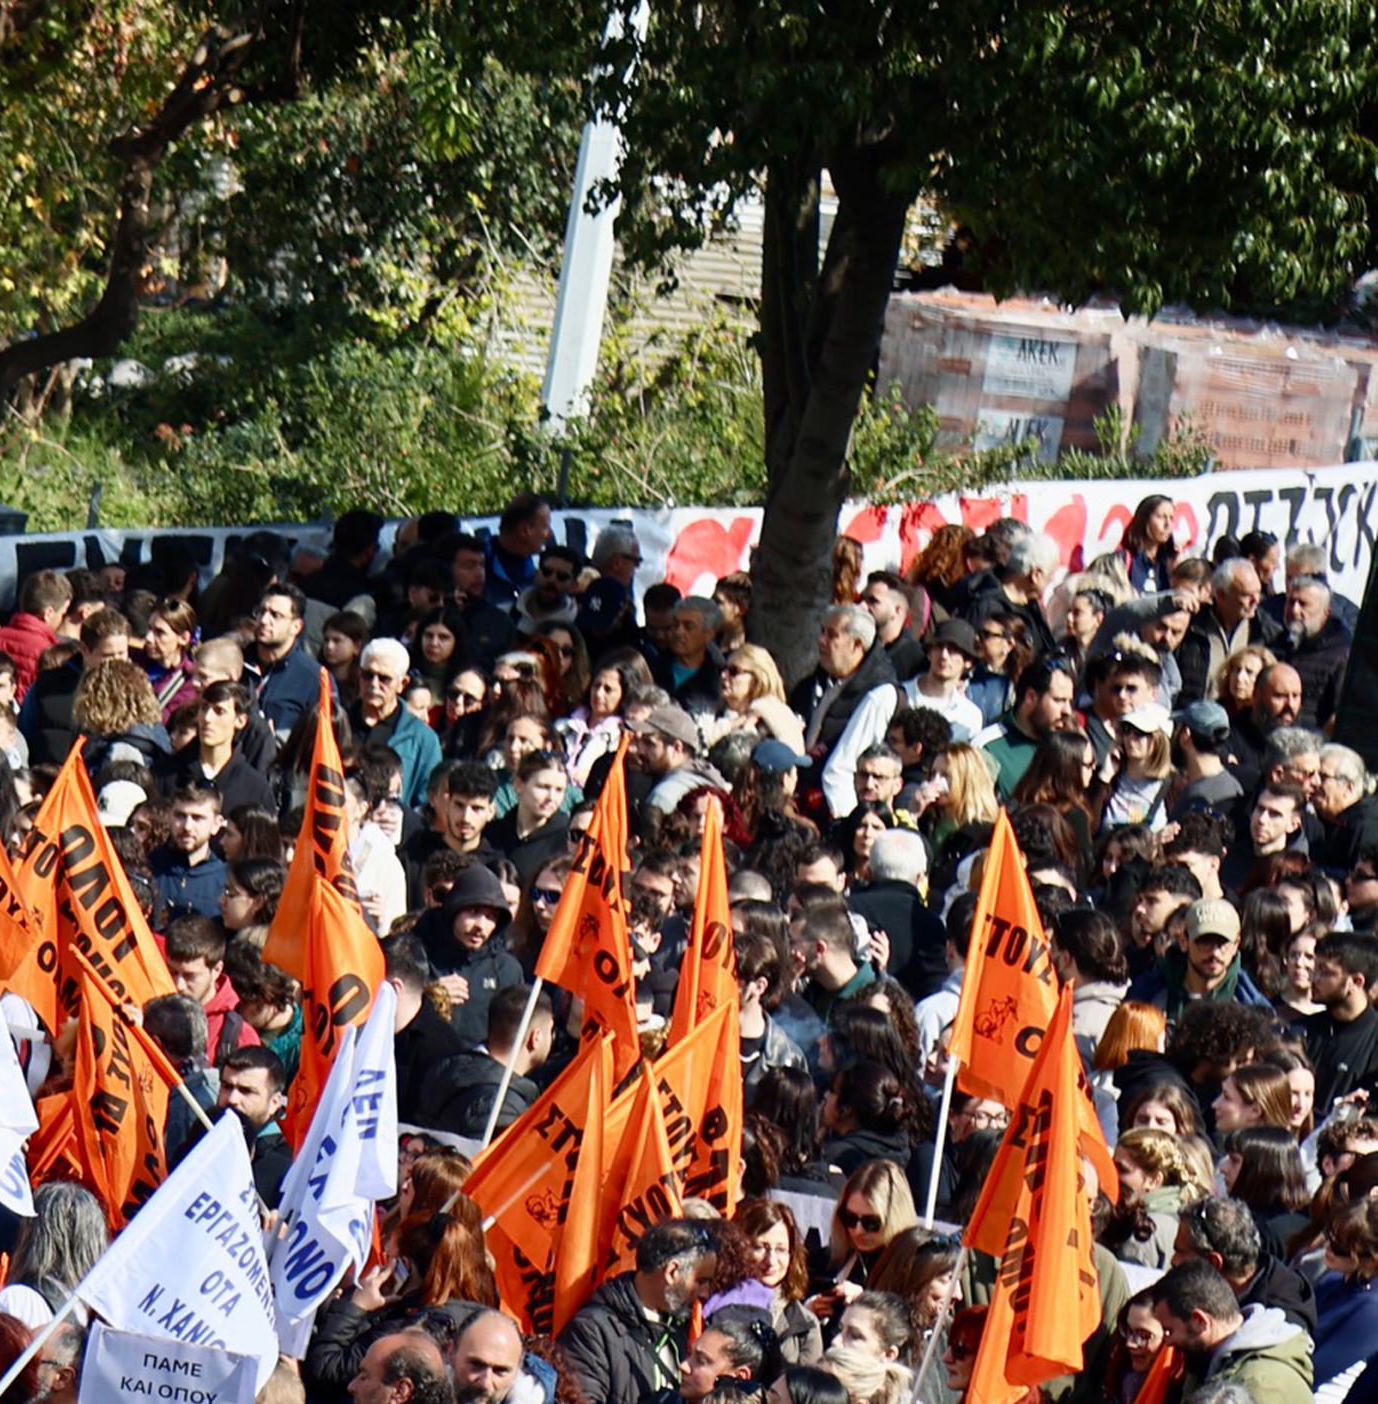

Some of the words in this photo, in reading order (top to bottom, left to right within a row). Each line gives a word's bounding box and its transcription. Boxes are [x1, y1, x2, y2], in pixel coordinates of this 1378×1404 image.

[138, 1283, 166, 1317] Ν.
[199, 1269, 243, 1318] ΟΤΑ
[143, 1353, 203, 1379] ΠΑΜΕ
[120, 1376, 153, 1397] ΚΑΙ
